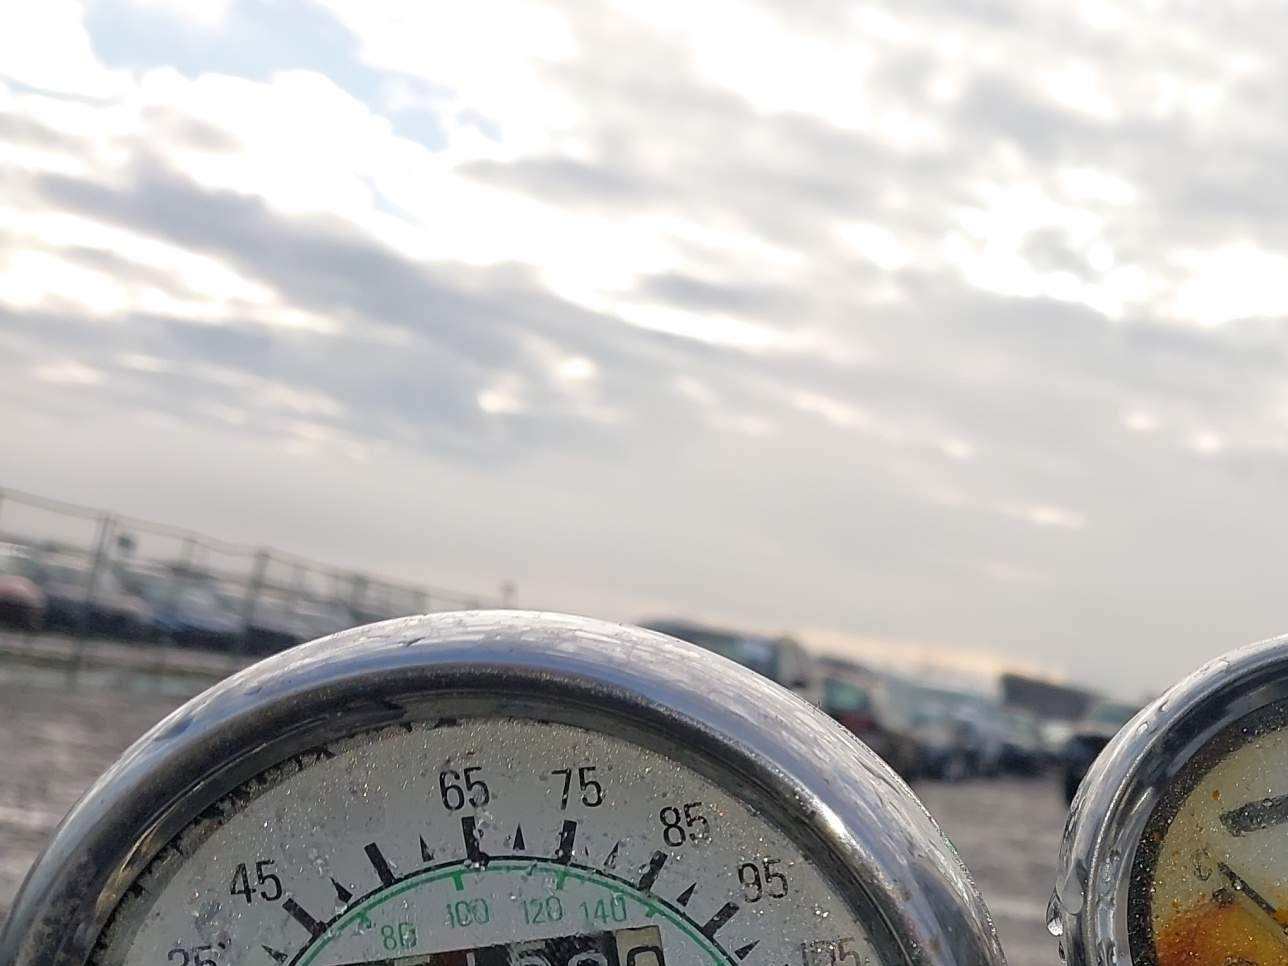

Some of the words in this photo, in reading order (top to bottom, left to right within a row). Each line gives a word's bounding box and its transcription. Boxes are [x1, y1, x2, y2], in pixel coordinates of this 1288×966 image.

[439, 766, 490, 811] 65
[551, 766, 604, 810] 75
[659, 801, 712, 848] 85
[229, 859, 284, 904] 45
[737, 858, 789, 904] 95
[447, 899, 491, 929] 100
[523, 896, 564, 925] 120
[579, 899, 628, 925] 140
